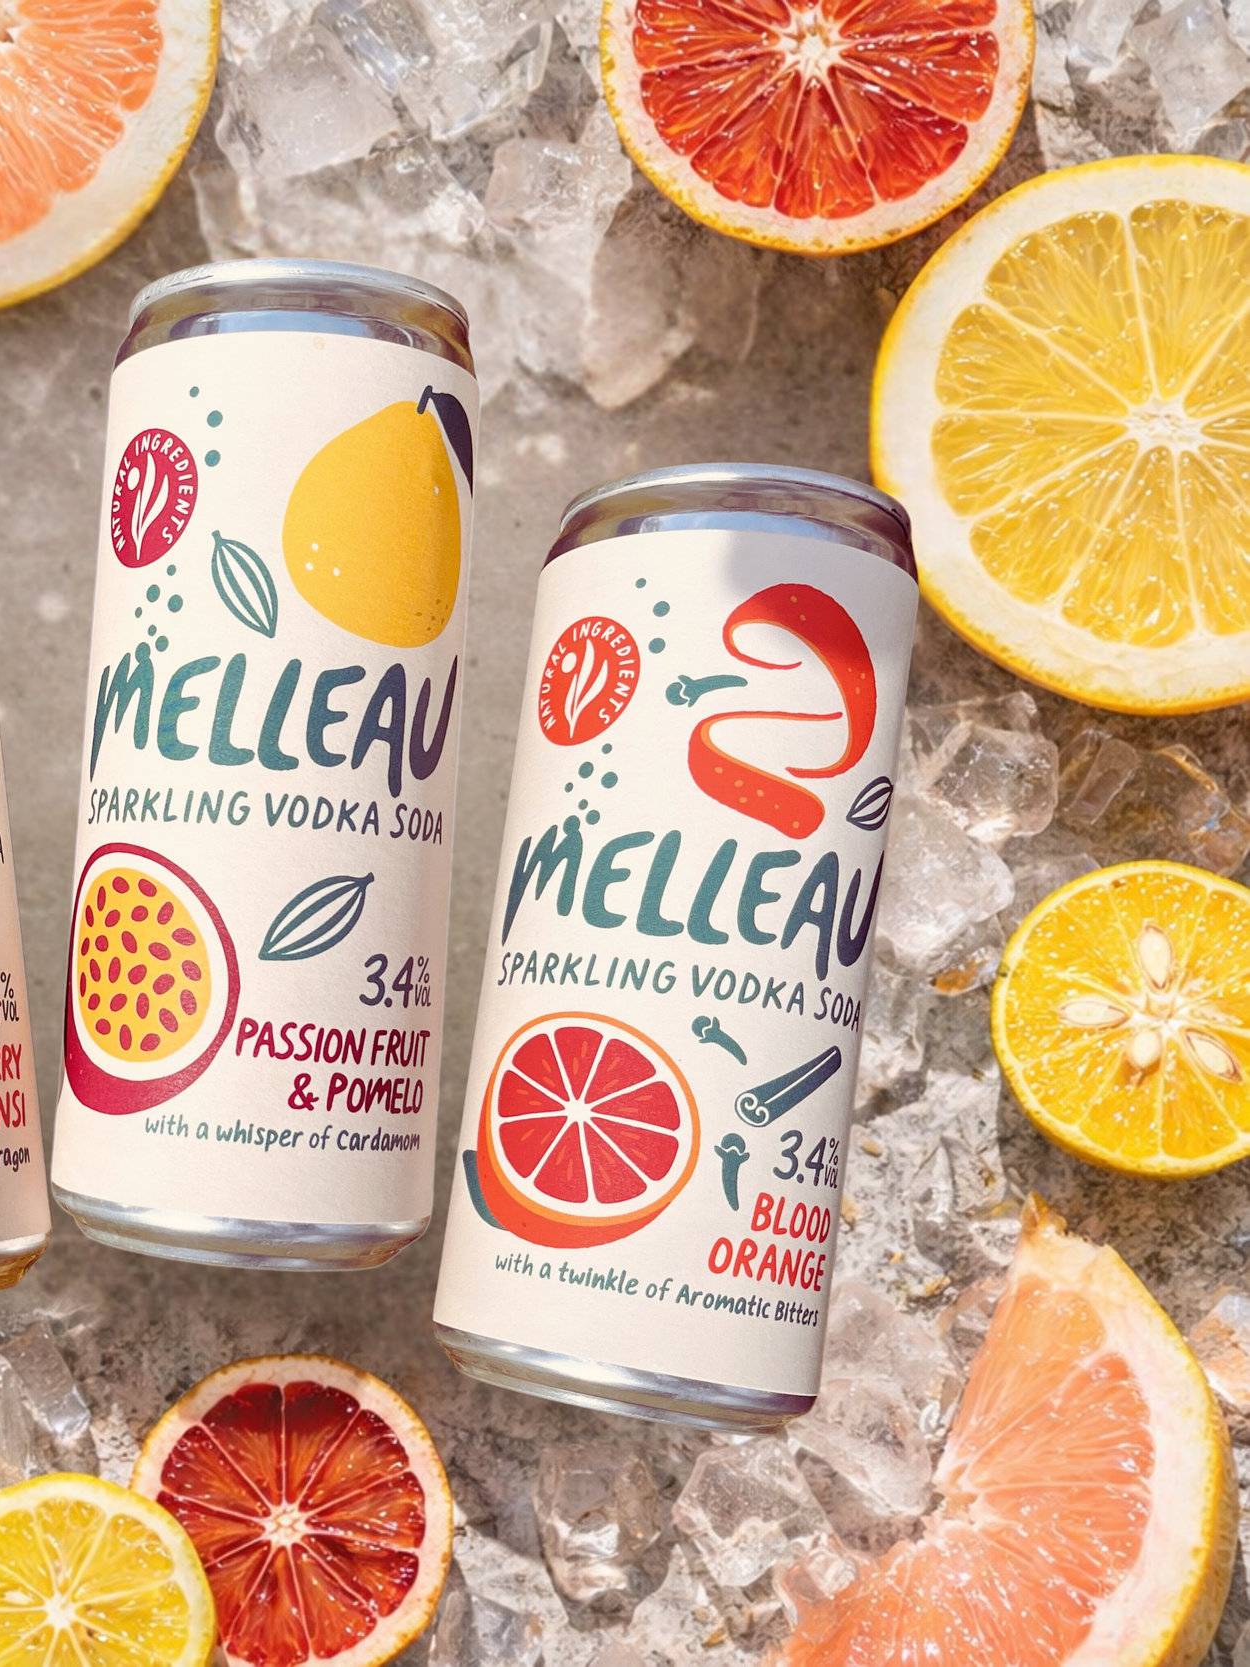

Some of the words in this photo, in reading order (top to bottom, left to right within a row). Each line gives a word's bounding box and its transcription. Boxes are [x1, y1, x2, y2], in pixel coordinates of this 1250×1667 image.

[112, 456, 132, 552] NATURAL
[135, 433, 194, 544] INGREDIENTS
[540, 642, 567, 730] NATURAL
[573, 620, 635, 724] INGREDIENTS
[90, 642, 458, 798] MELLEAU
[88, 786, 250, 826] SPARKLING
[265, 792, 380, 836] VODKA
[390, 803, 443, 845] SODA
[502, 815, 885, 982] MELLEAU
[2, 1000, 20, 1022] VOL
[414, 984, 432, 1008] VOL
[497, 950, 677, 994] SPARKLING
[691, 964, 804, 1016] VODKA
[813, 986, 861, 1034] SODA
[236, 1017, 366, 1065] PASSION
[370, 1029, 431, 1068] FRUIT
[287, 1072, 320, 1112] &
[326, 1072, 423, 1114] POMELO
[145, 1114, 189, 1138] with
[196, 1122, 209, 1140] a
[216, 1119, 304, 1152] whisper
[308, 1124, 334, 1150] of
[336, 1126, 420, 1152] Cardamom
[824, 1166, 839, 1190] VOL
[750, 1192, 832, 1244] BLOOD
[494, 1253, 534, 1278] with
[538, 1262, 552, 1280] a
[558, 1260, 638, 1296] twinkle
[645, 1276, 674, 1302] of
[675, 1284, 770, 1320] Aromatic
[774, 1300, 820, 1328] Bitters
[708, 1236, 826, 1292] ORANGE
